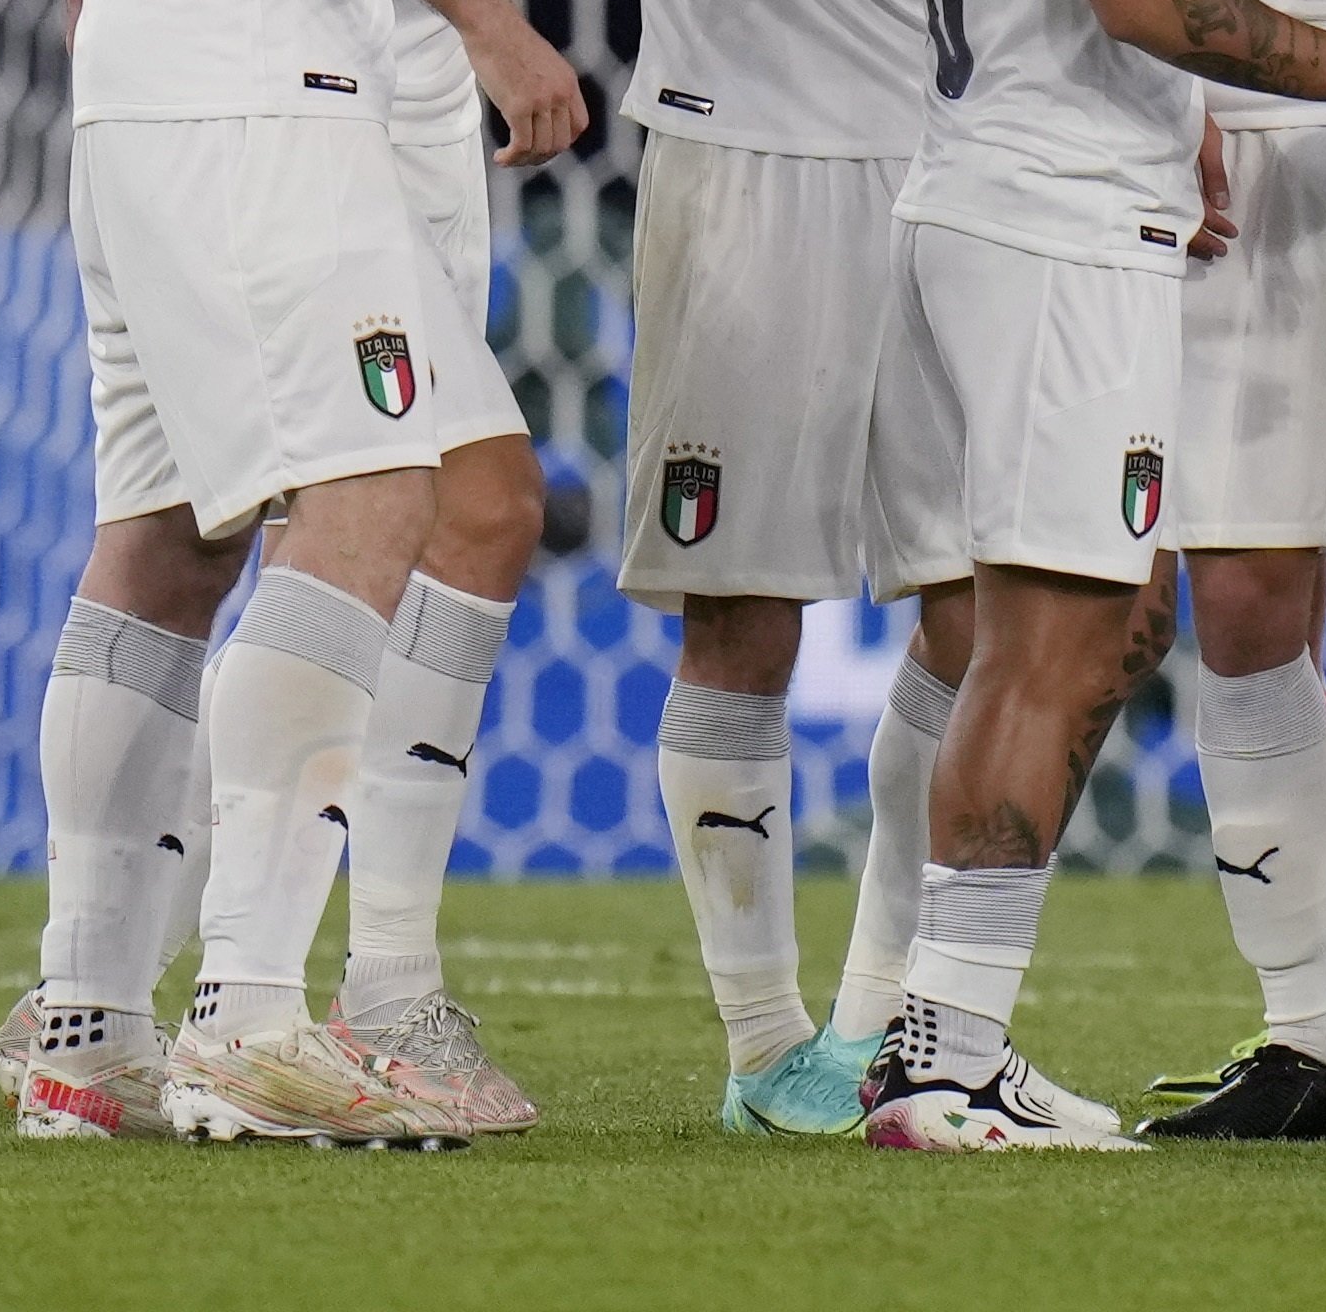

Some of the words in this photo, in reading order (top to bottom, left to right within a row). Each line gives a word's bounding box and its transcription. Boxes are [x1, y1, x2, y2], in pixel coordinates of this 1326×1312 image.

[360, 338, 405, 356] ITALIA
[668, 465, 716, 481] ITALIA
[1128, 456, 1161, 473] ITALIA
